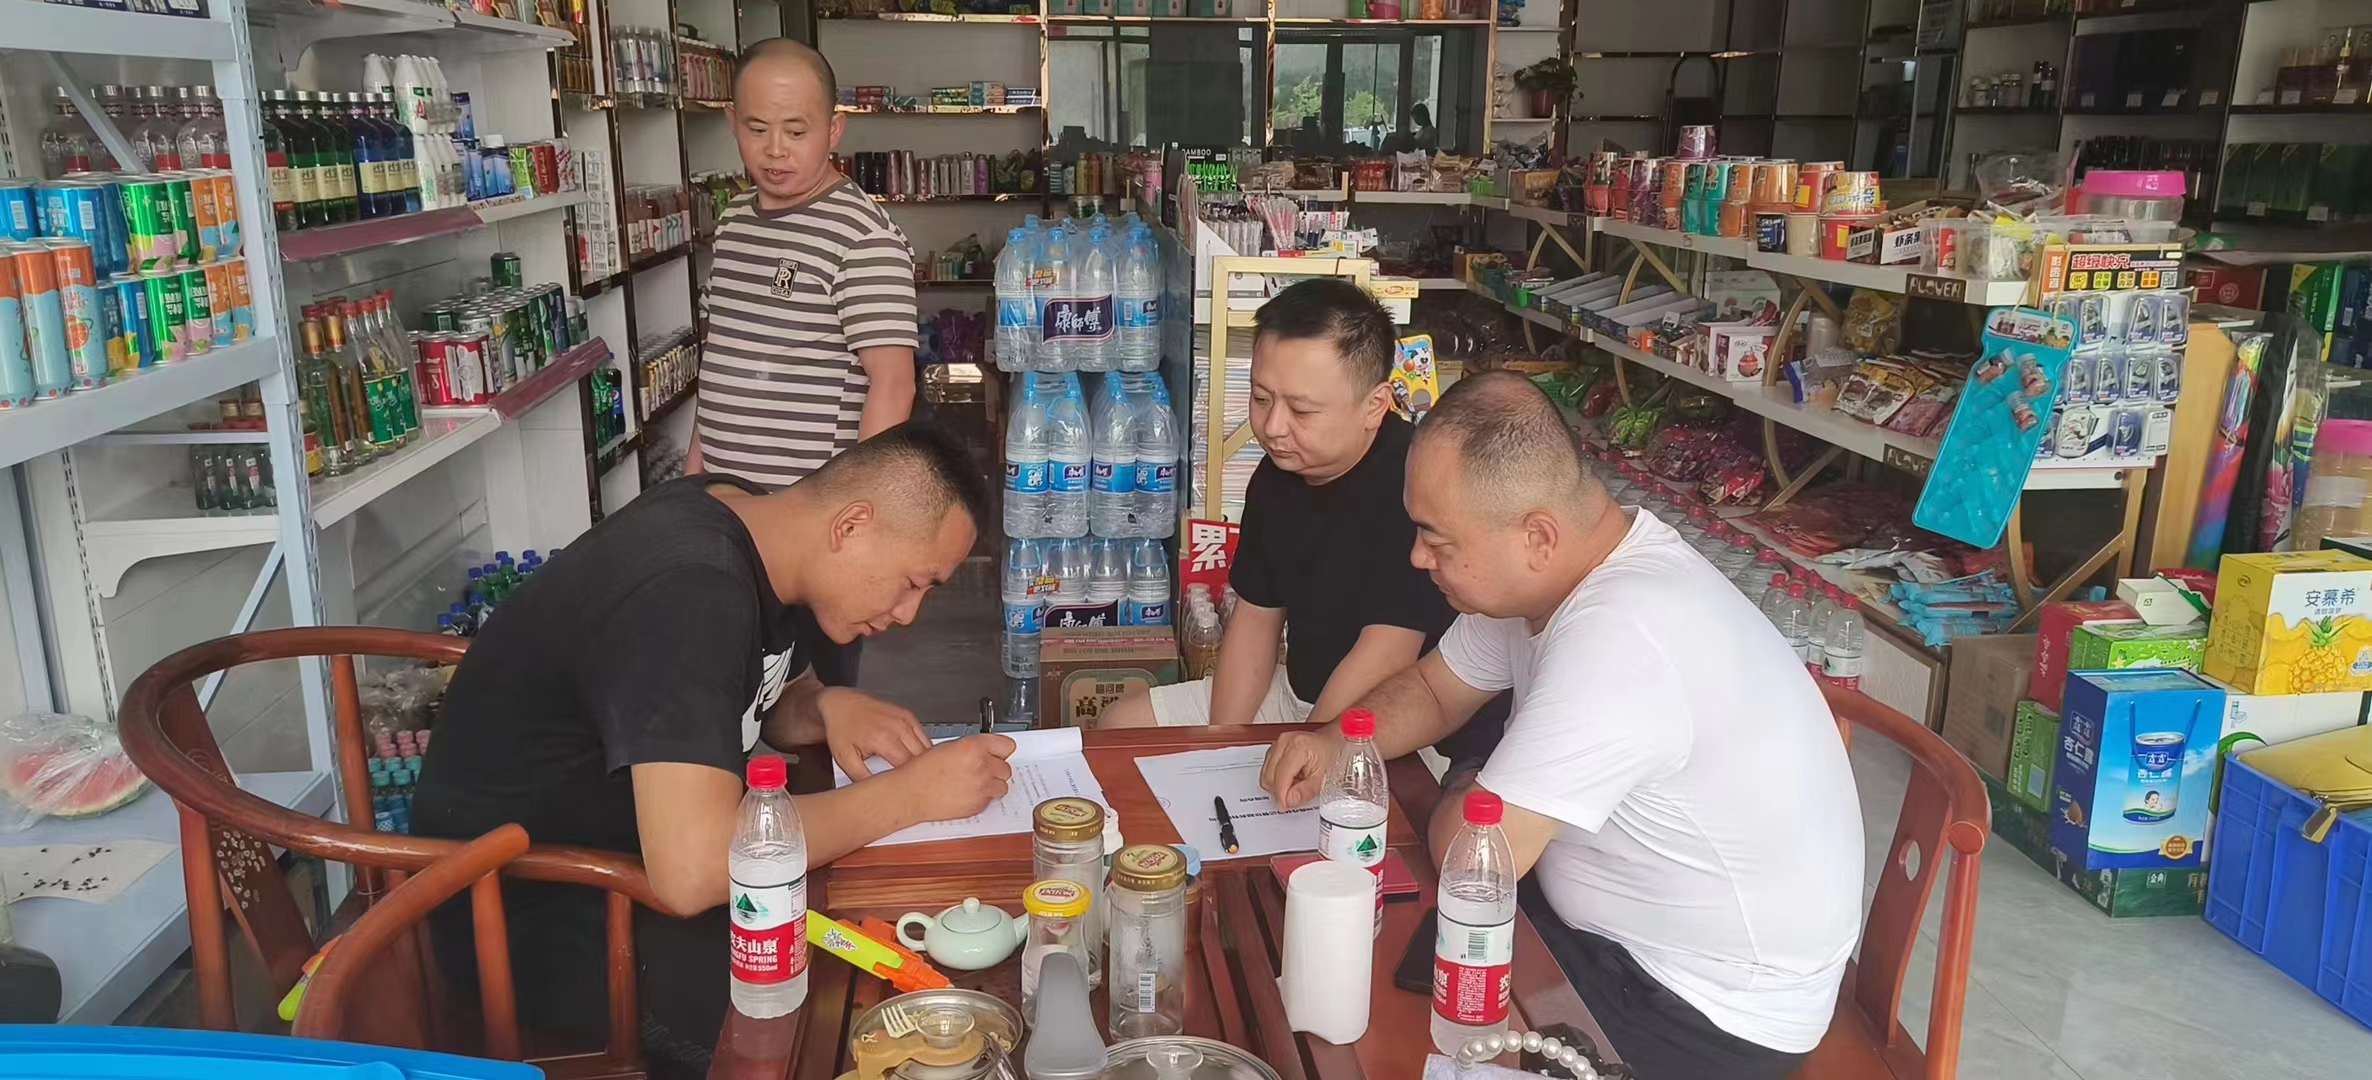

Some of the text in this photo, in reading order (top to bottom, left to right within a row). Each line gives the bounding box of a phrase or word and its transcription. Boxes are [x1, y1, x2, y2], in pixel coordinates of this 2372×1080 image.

[2071, 253, 2131, 270] 超级快充
[1887, 448, 1929, 475] PLOVE
[1191, 522, 1239, 573] 累
[2304, 587, 2356, 608] 安慕希
[748, 955, 778, 964] SPRING
